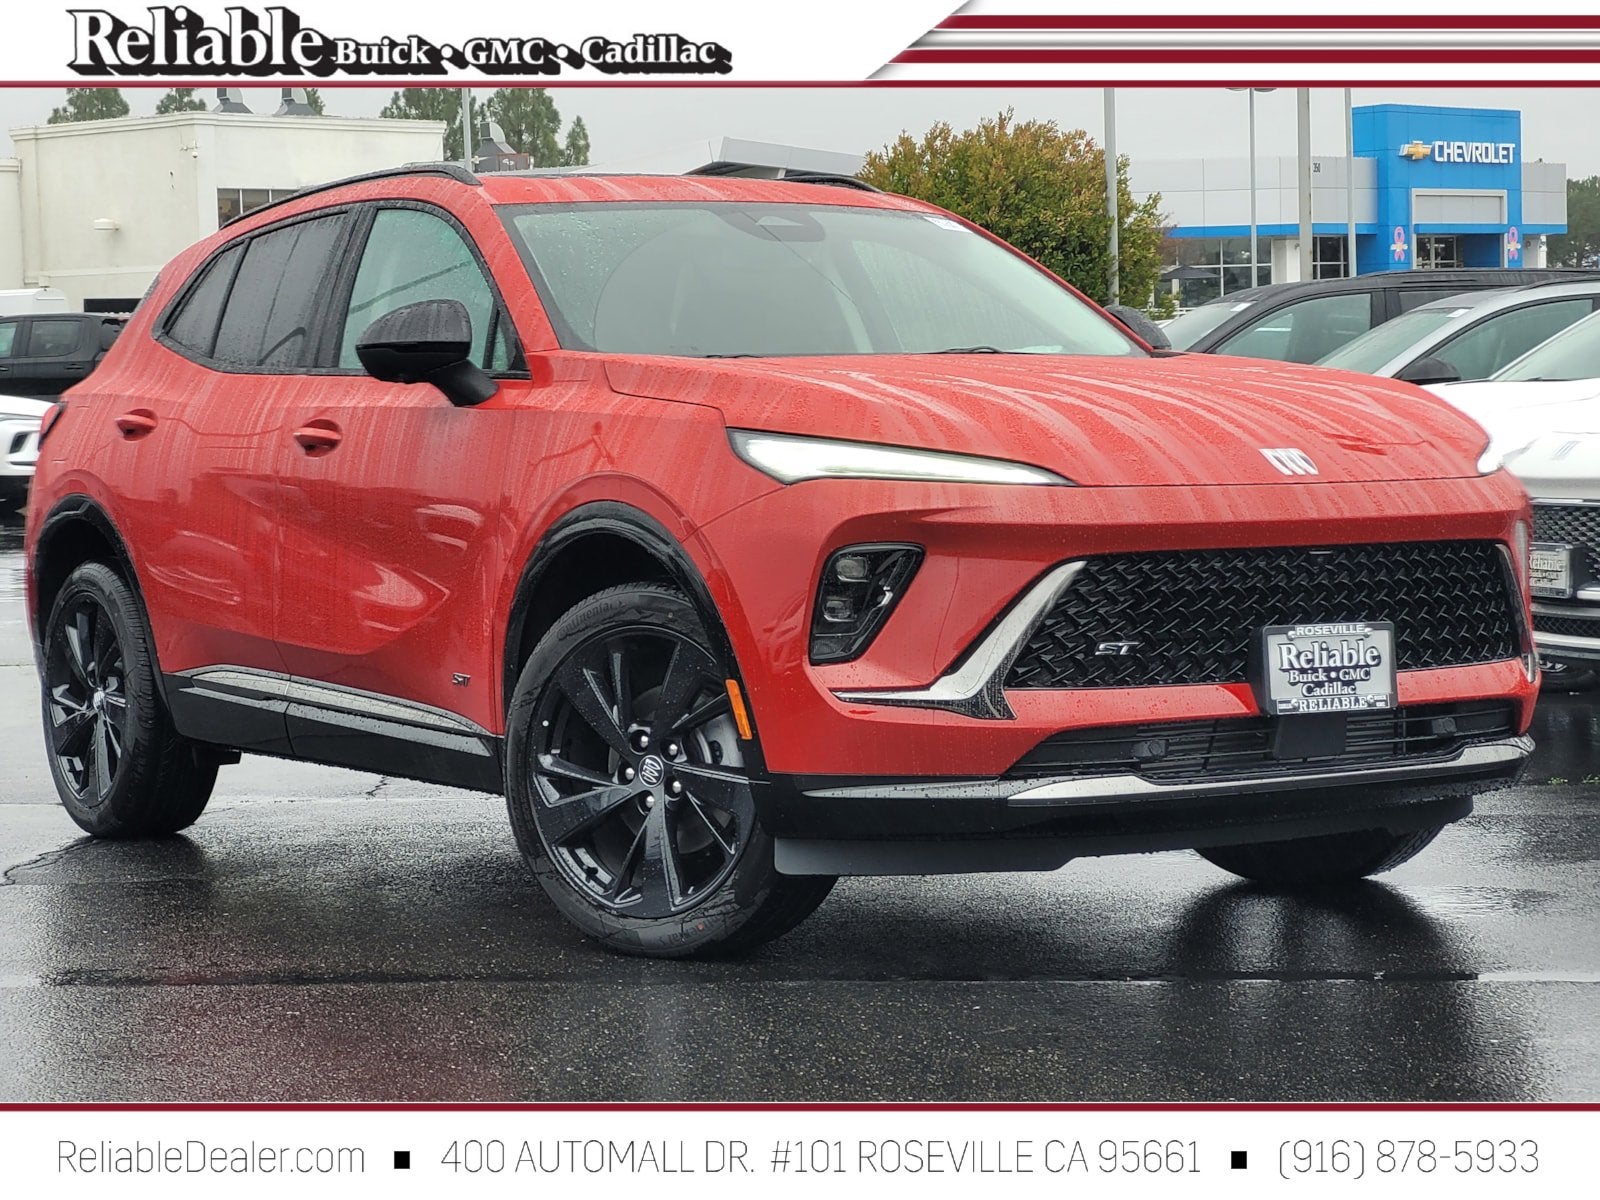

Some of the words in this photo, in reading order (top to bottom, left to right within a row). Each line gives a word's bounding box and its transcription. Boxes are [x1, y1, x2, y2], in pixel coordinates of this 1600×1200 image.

[1433, 140, 1516, 164] CHEVROLET
[1295, 624, 1366, 636] ROSEVILLE
[1094, 642, 1140, 656] ST
[1278, 638, 1381, 671] Reliable
[452, 672, 471, 687] ST
[1289, 669, 1328, 684] Buick
[1339, 667, 1371, 682] GMC
[1301, 681, 1357, 697] Cadillac
[1298, 696, 1368, 712] RELIABLE
